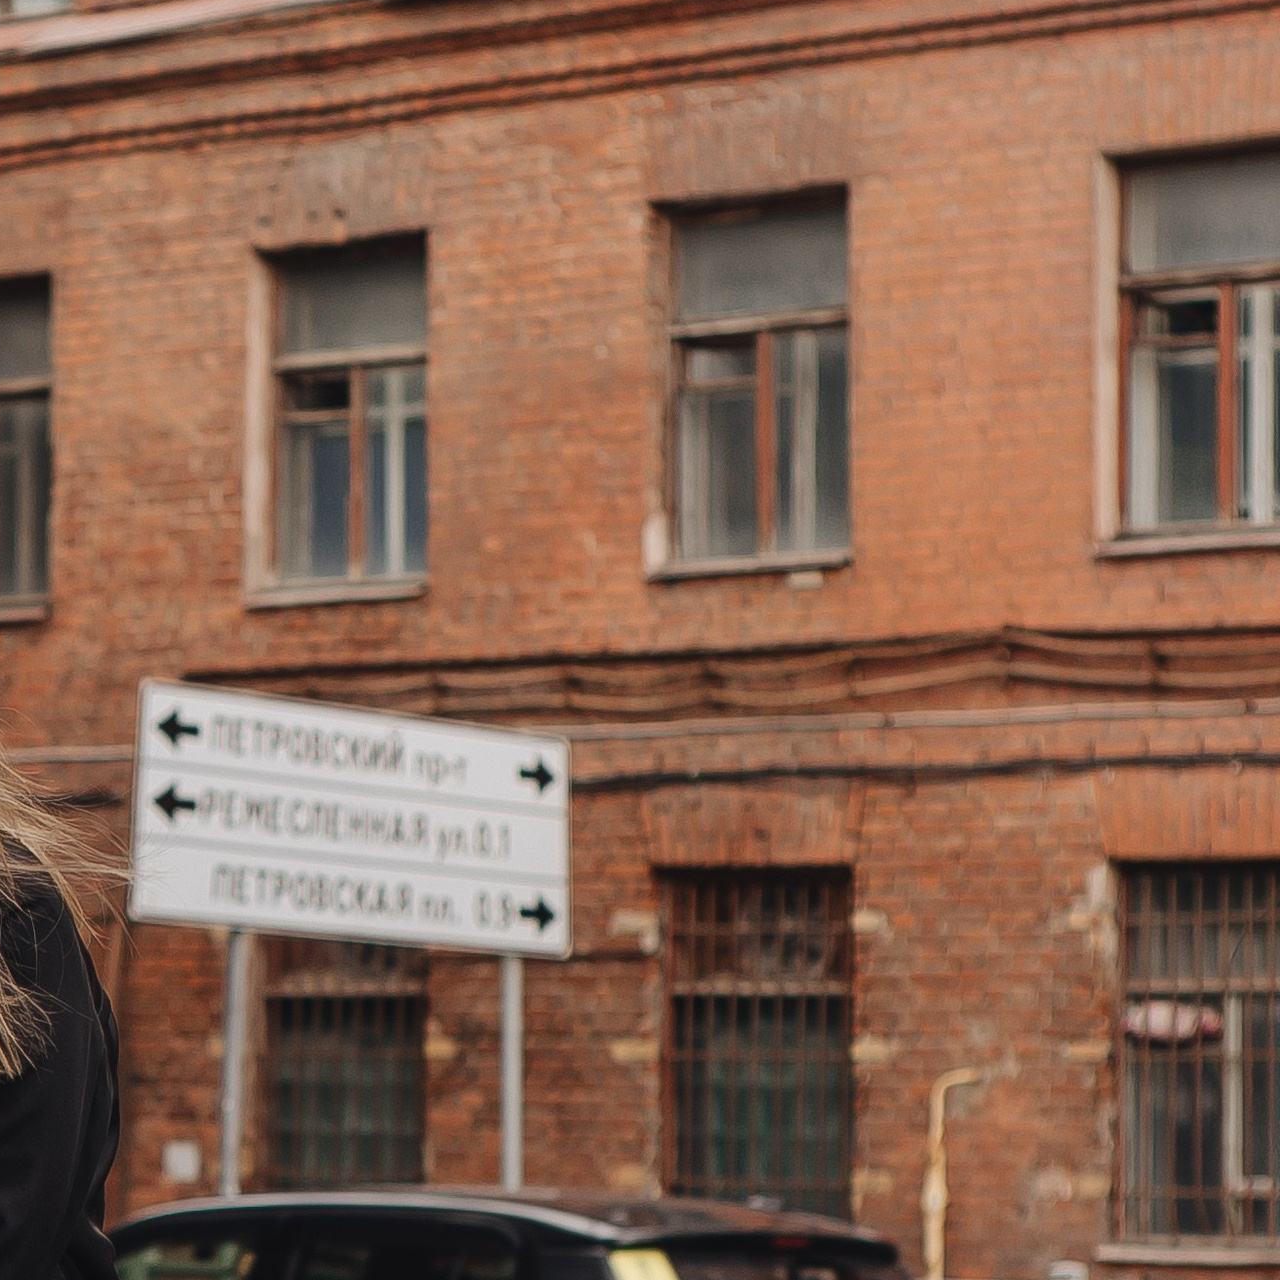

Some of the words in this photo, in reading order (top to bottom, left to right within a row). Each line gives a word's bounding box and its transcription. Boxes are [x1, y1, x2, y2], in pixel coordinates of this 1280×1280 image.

[210, 713, 405, 776] ПЕТРОВСКИЙ
[413, 752, 468, 787] пр-т
[201, 786, 429, 846] РЕМЕСЛЕННАЯ
[210, 862, 413, 918] ПЕТРОВСКАЯ
